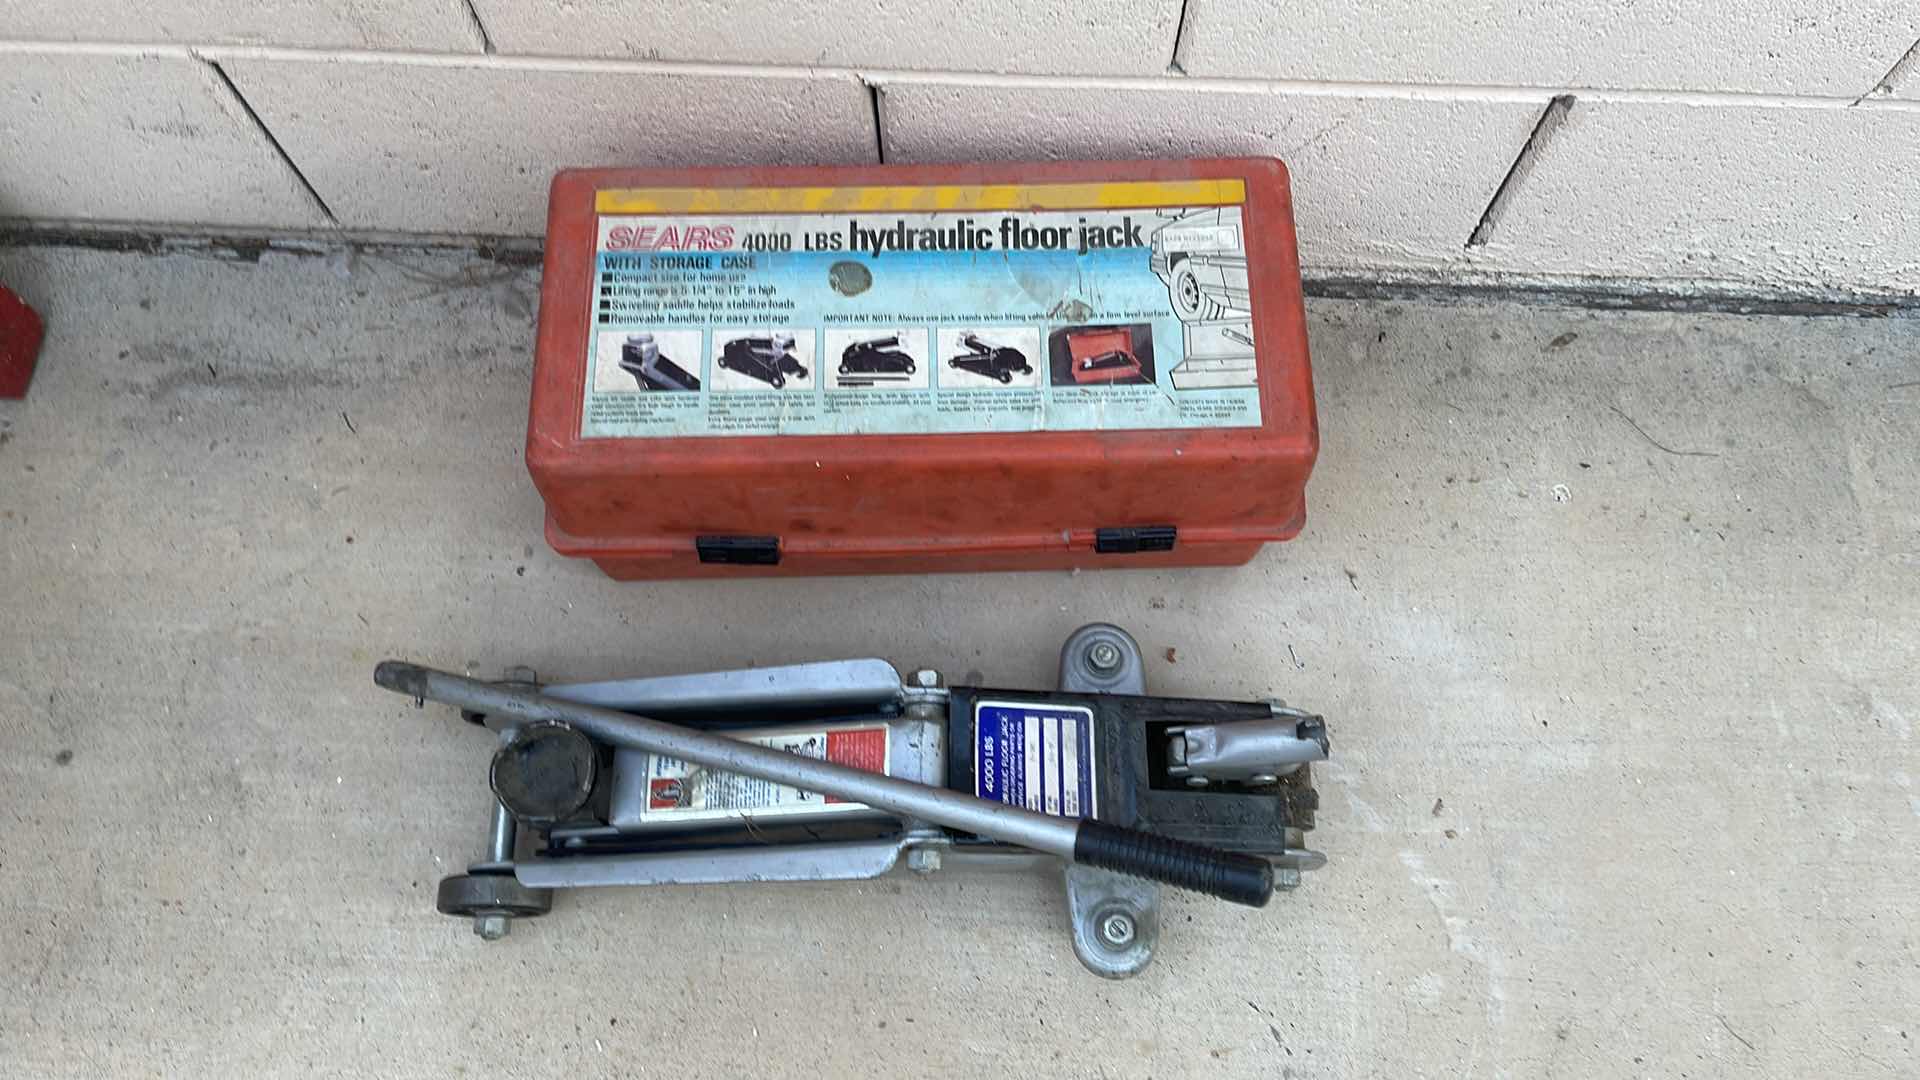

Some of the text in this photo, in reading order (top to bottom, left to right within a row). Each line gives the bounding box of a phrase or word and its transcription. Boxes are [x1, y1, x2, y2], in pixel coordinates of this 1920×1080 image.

[605, 216, 1145, 258] SEARS 4000 LBS hydraulic floor jack
[604, 255, 757, 270] WITH STORAGE CASE
[614, 271, 658, 284] Compact
[682, 271, 696, 282] for
[700, 271, 727, 282] home
[613, 284, 641, 297] Lifting
[643, 286, 668, 298] range
[758, 283, 777, 298] high
[611, 298, 795, 312] Swiveling saddle helps stabilize loads
[610, 312, 790, 326] Removable handles for easy storage
[823, 312, 870, 323] IMPORTANT
[984, 735, 994, 793] 4000 LBS
